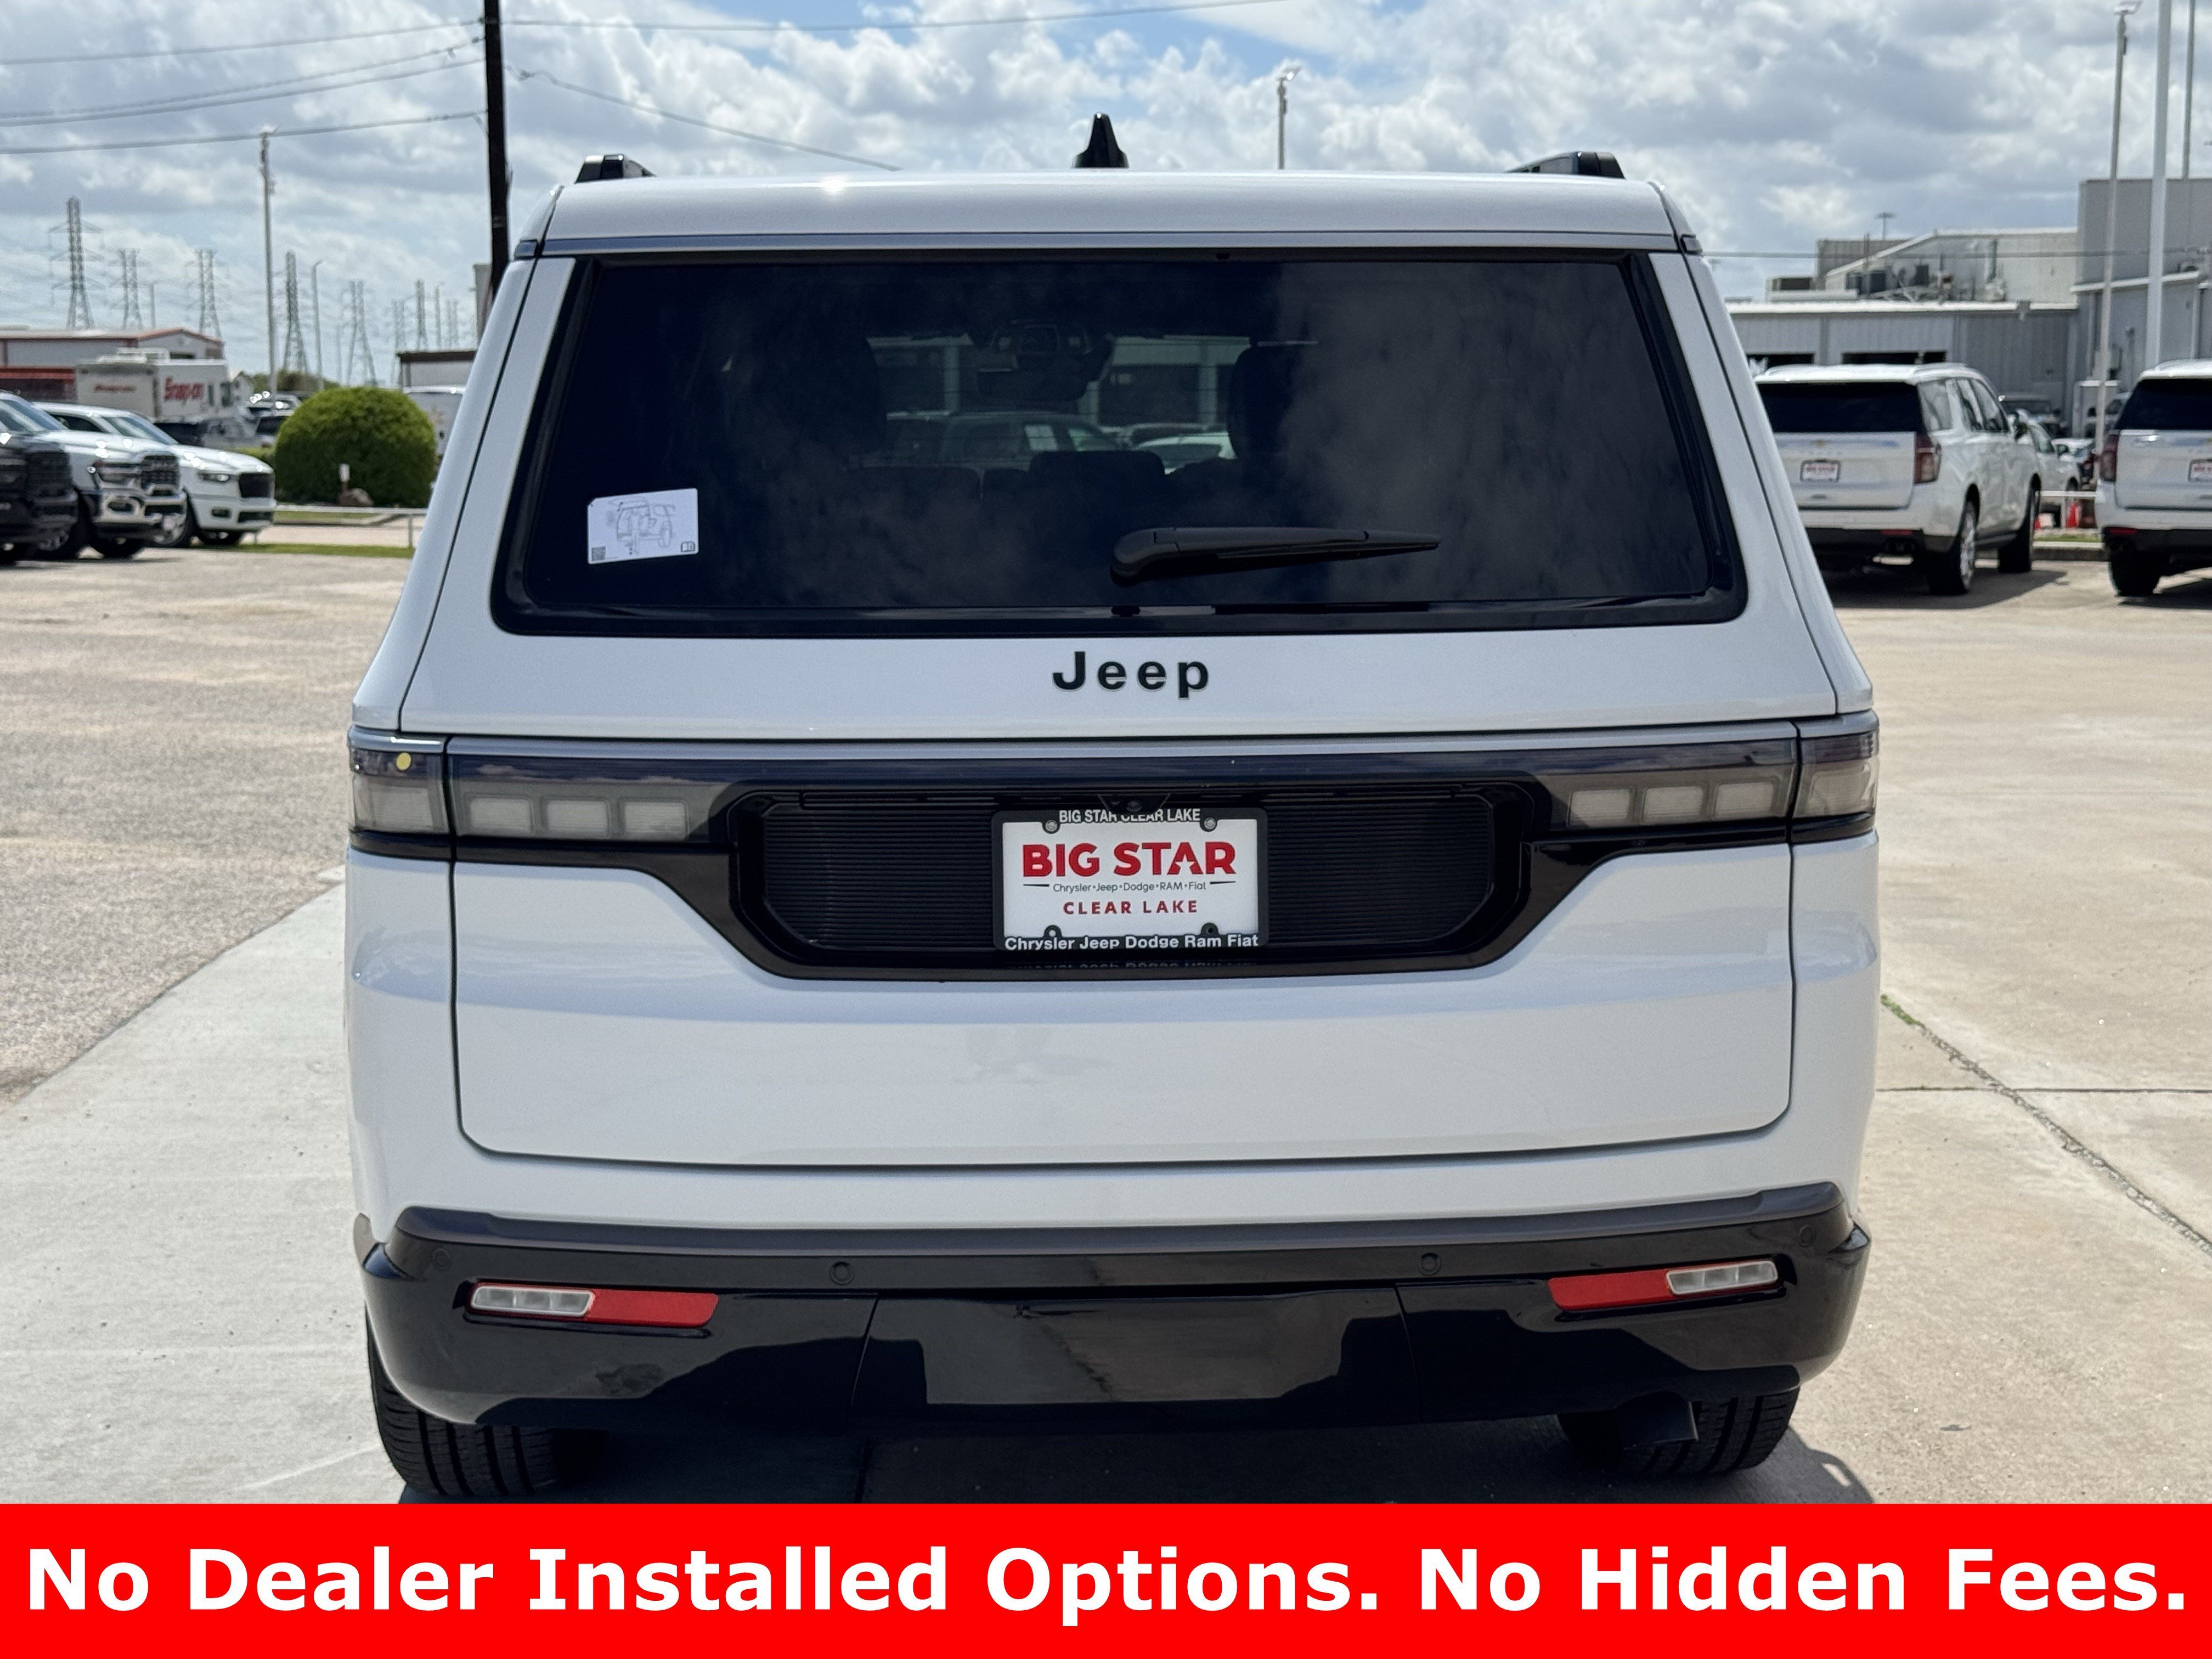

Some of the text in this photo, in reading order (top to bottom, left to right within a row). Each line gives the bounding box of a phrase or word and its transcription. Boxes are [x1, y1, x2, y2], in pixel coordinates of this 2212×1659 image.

[1052, 651, 1209, 698] Jeep
[1059, 809, 1081, 822] BIG
[1085, 809, 1117, 822] STAR
[1167, 808, 1200, 821] LAKE
[1022, 840, 1237, 877] BIG STAR
[1053, 881, 1206, 893] Chrysler Jeep Dodge RAM Fiat
[1063, 900, 1198, 915] CLEAR LAKE
[1005, 934, 1259, 950] Chrysler Jeep Dodge Ram Fiat
